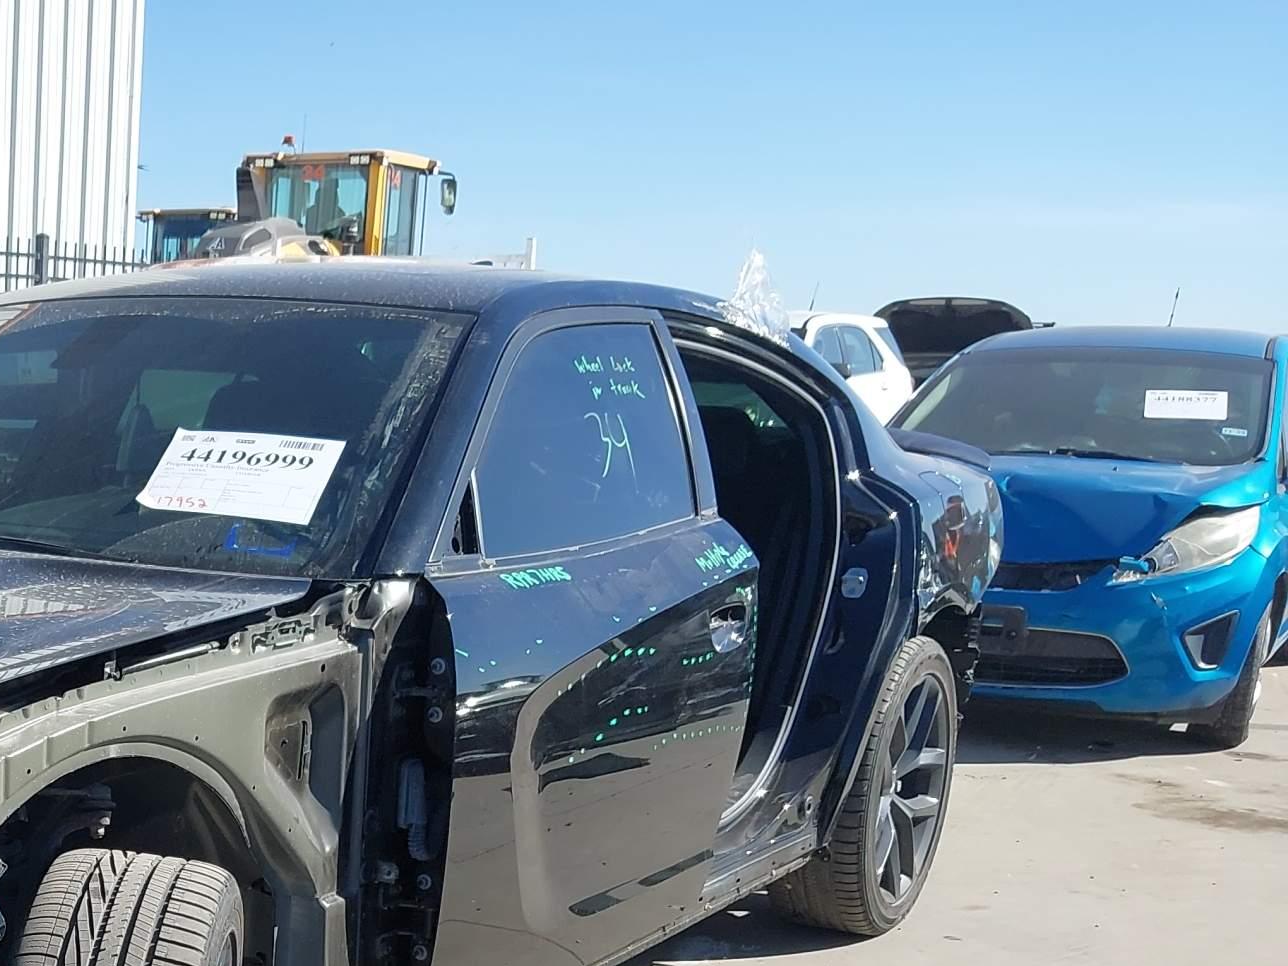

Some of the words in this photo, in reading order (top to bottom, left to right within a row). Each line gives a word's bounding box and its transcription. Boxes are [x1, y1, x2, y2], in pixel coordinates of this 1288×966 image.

[180, 447, 315, 471] 44196999
[583, 411, 638, 492] 34
[156, 495, 209, 509] 17952
